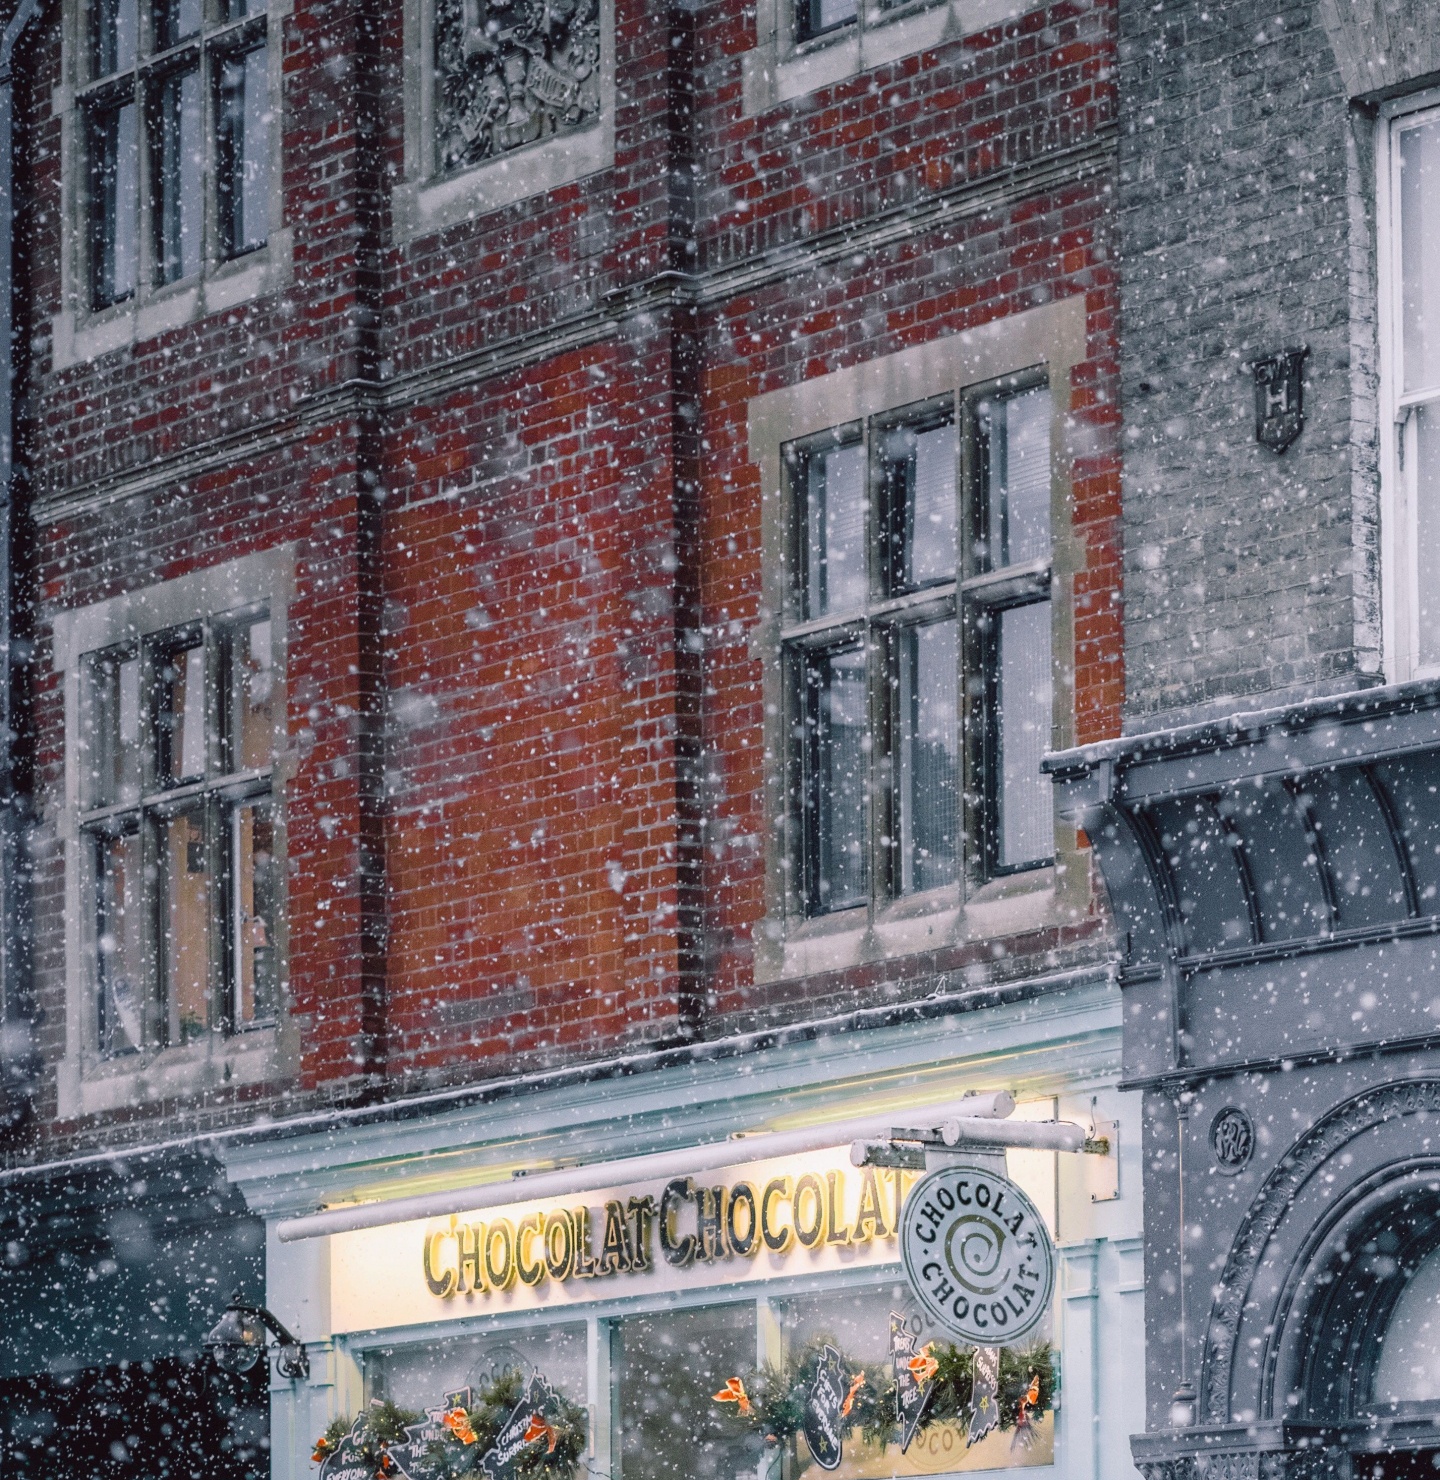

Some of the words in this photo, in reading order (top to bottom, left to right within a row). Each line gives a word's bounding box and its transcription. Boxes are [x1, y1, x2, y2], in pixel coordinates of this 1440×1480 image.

[1265, 379, 1288, 418] H
[423, 1194, 656, 1299] CHOCOLAT
[915, 1181, 1038, 1249] CHOCOLAT
[922, 1262, 1039, 1329] CHOCOLAT
[409, 1444, 430, 1458] THE
